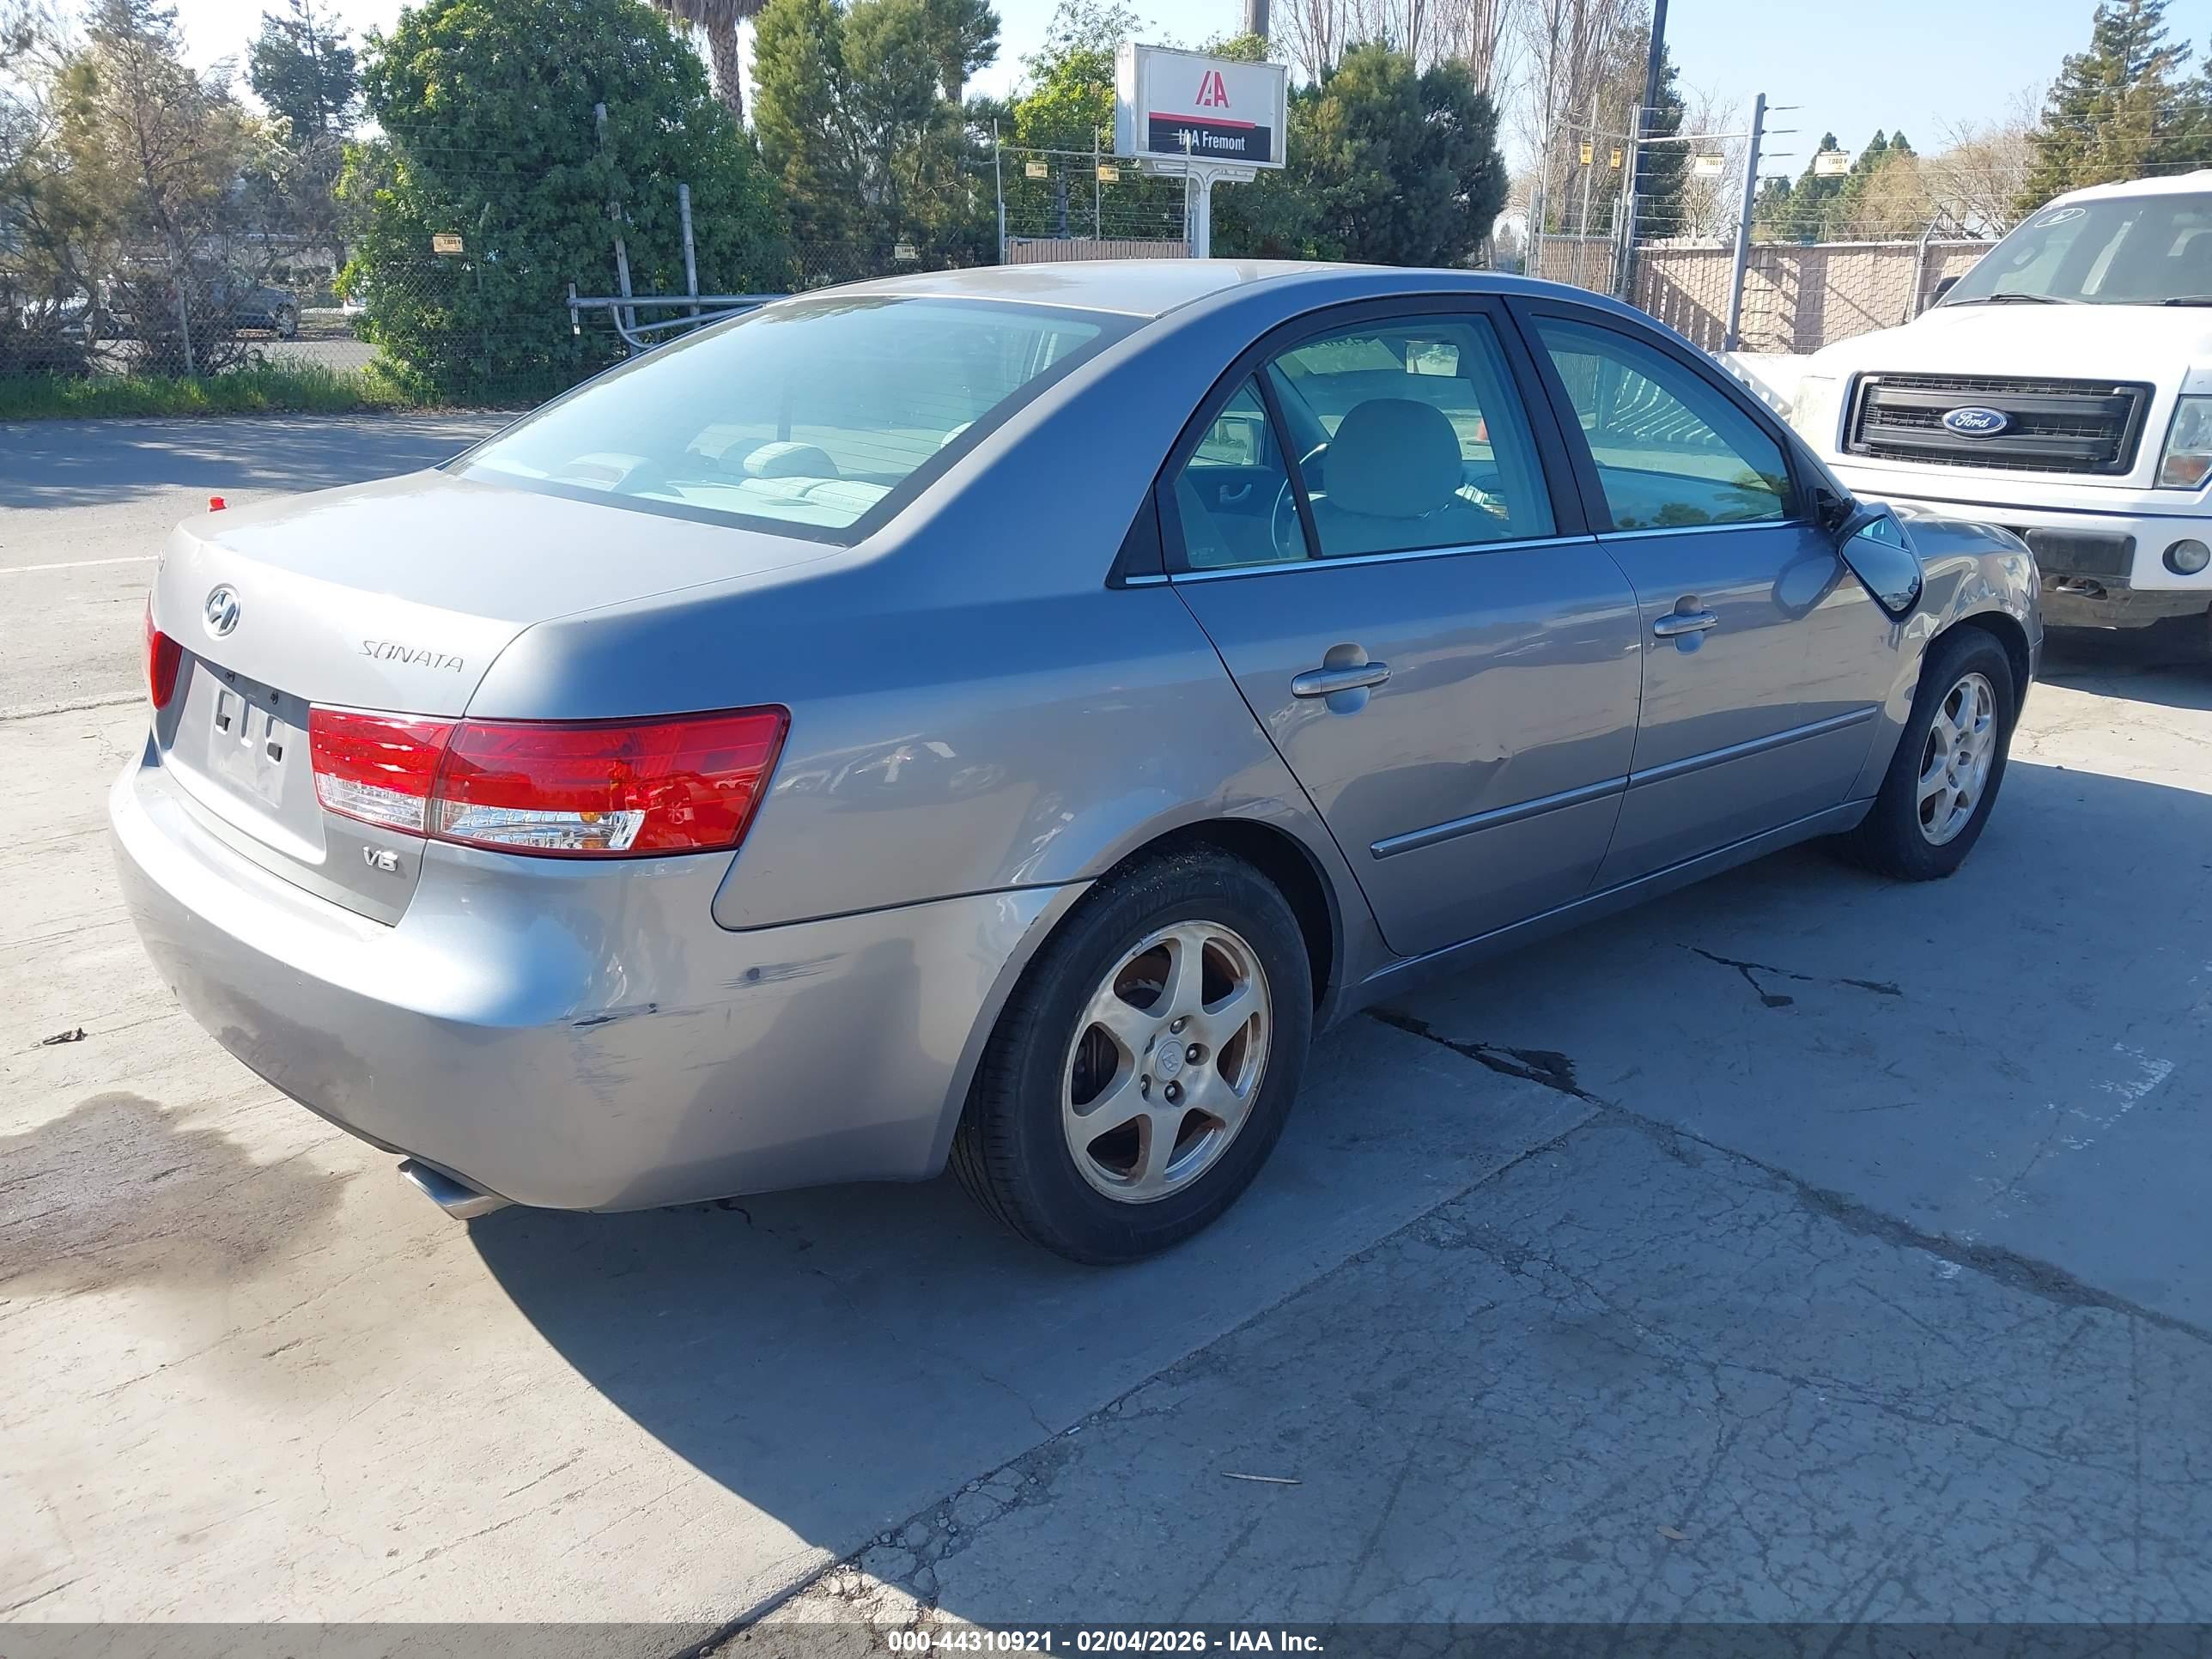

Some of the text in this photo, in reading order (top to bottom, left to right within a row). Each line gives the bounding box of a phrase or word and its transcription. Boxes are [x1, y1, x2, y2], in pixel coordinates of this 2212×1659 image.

[1202, 131, 1245, 151] Fremont
[1955, 412, 1991, 428] Ford
[358, 640, 464, 672] SONATA
[362, 846, 398, 872] V6
